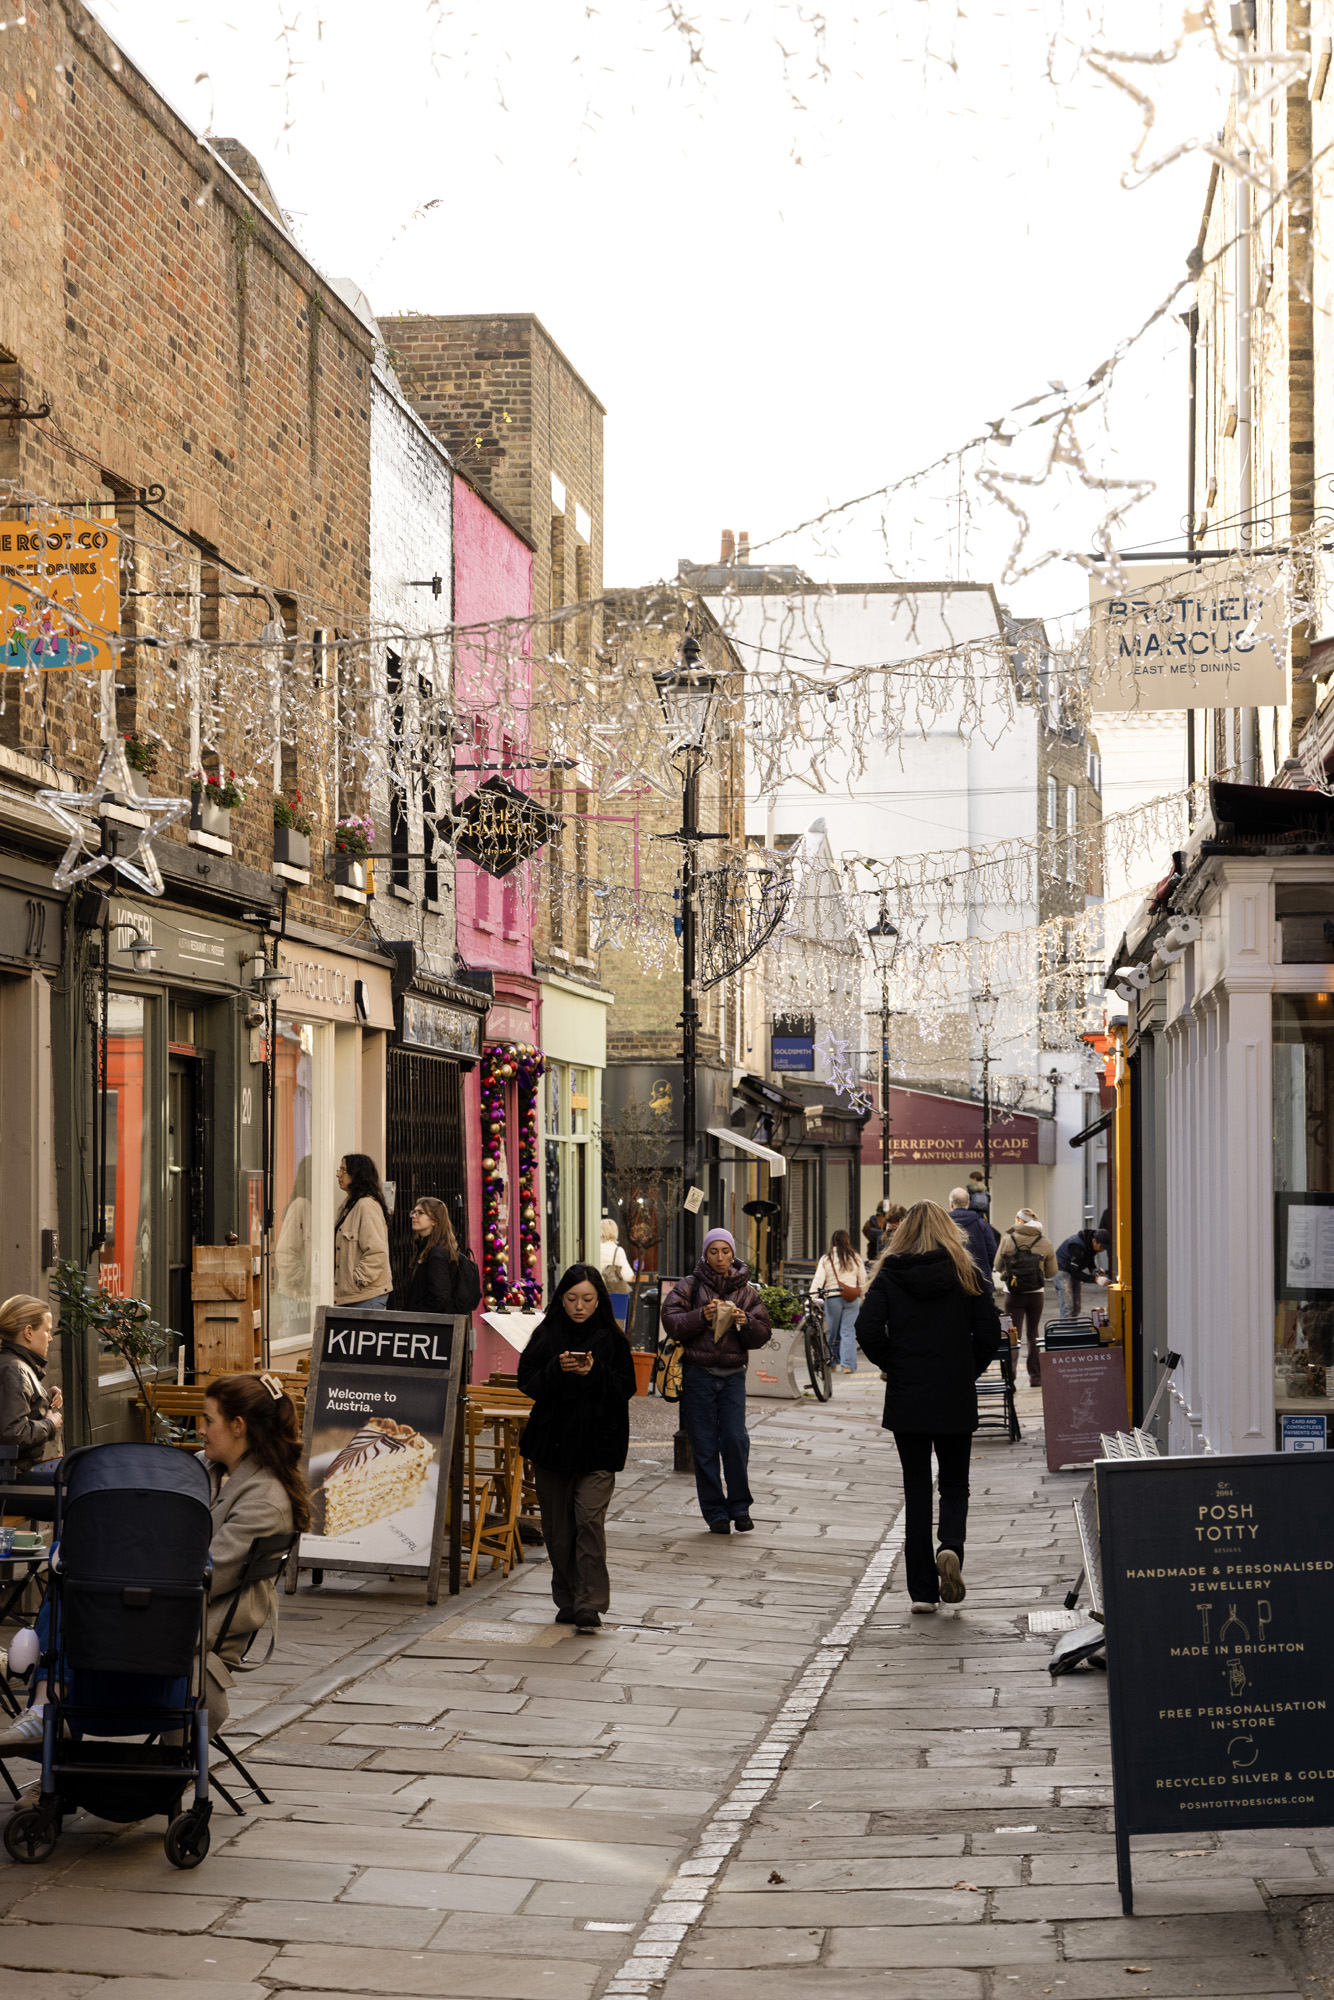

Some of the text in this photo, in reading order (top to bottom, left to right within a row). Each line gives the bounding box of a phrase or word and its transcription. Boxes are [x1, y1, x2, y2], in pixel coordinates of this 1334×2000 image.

[0, 532, 109, 551] E ROOT CO
[46, 562, 97, 576] DRINKS
[1108, 597, 1264, 625] BROTHER
[1118, 629, 1256, 657] MARCUS
[1134, 662, 1241, 675] EAST MED DINING
[480, 808, 517, 822] THE
[117, 908, 157, 958] KIPFERL
[286, 960, 352, 1005] ANGELICA
[242, 1087, 252, 1125] 20
[974, 1138, 1029, 1149] ARCADE
[921, 1151, 994, 1160] ANTIQUE SHOS
[328, 1329, 448, 1361] KIPFERL
[1052, 1353, 1112, 1365] BACKWORKS
[328, 1387, 397, 1402] Welcome to
[326, 1399, 374, 1413] Austria.
[1215, 1489, 1233, 1498] 2004
[1198, 1504, 1253, 1520] POSH
[389, 1525, 417, 1552] KIPFERL
[1194, 1524, 1259, 1541] TOTTY
[1213, 1546, 1242, 1554] DESIGNS
[1126, 1560, 1334, 1579] HANDMADE & PERSONALISED
[1189, 1580, 1272, 1592] JEWELLERY
[1170, 1643, 1305, 1657] MADE IN BRIGHTON
[1159, 1700, 1327, 1719] FREE PERSONALISATION
[1211, 1717, 1276, 1730] IN-STORE
[1156, 1769, 1334, 1789] RECYCLED SILVER & GOLD
[1180, 1796, 1315, 1810] POSHTOTTYDESIGNS.COM
